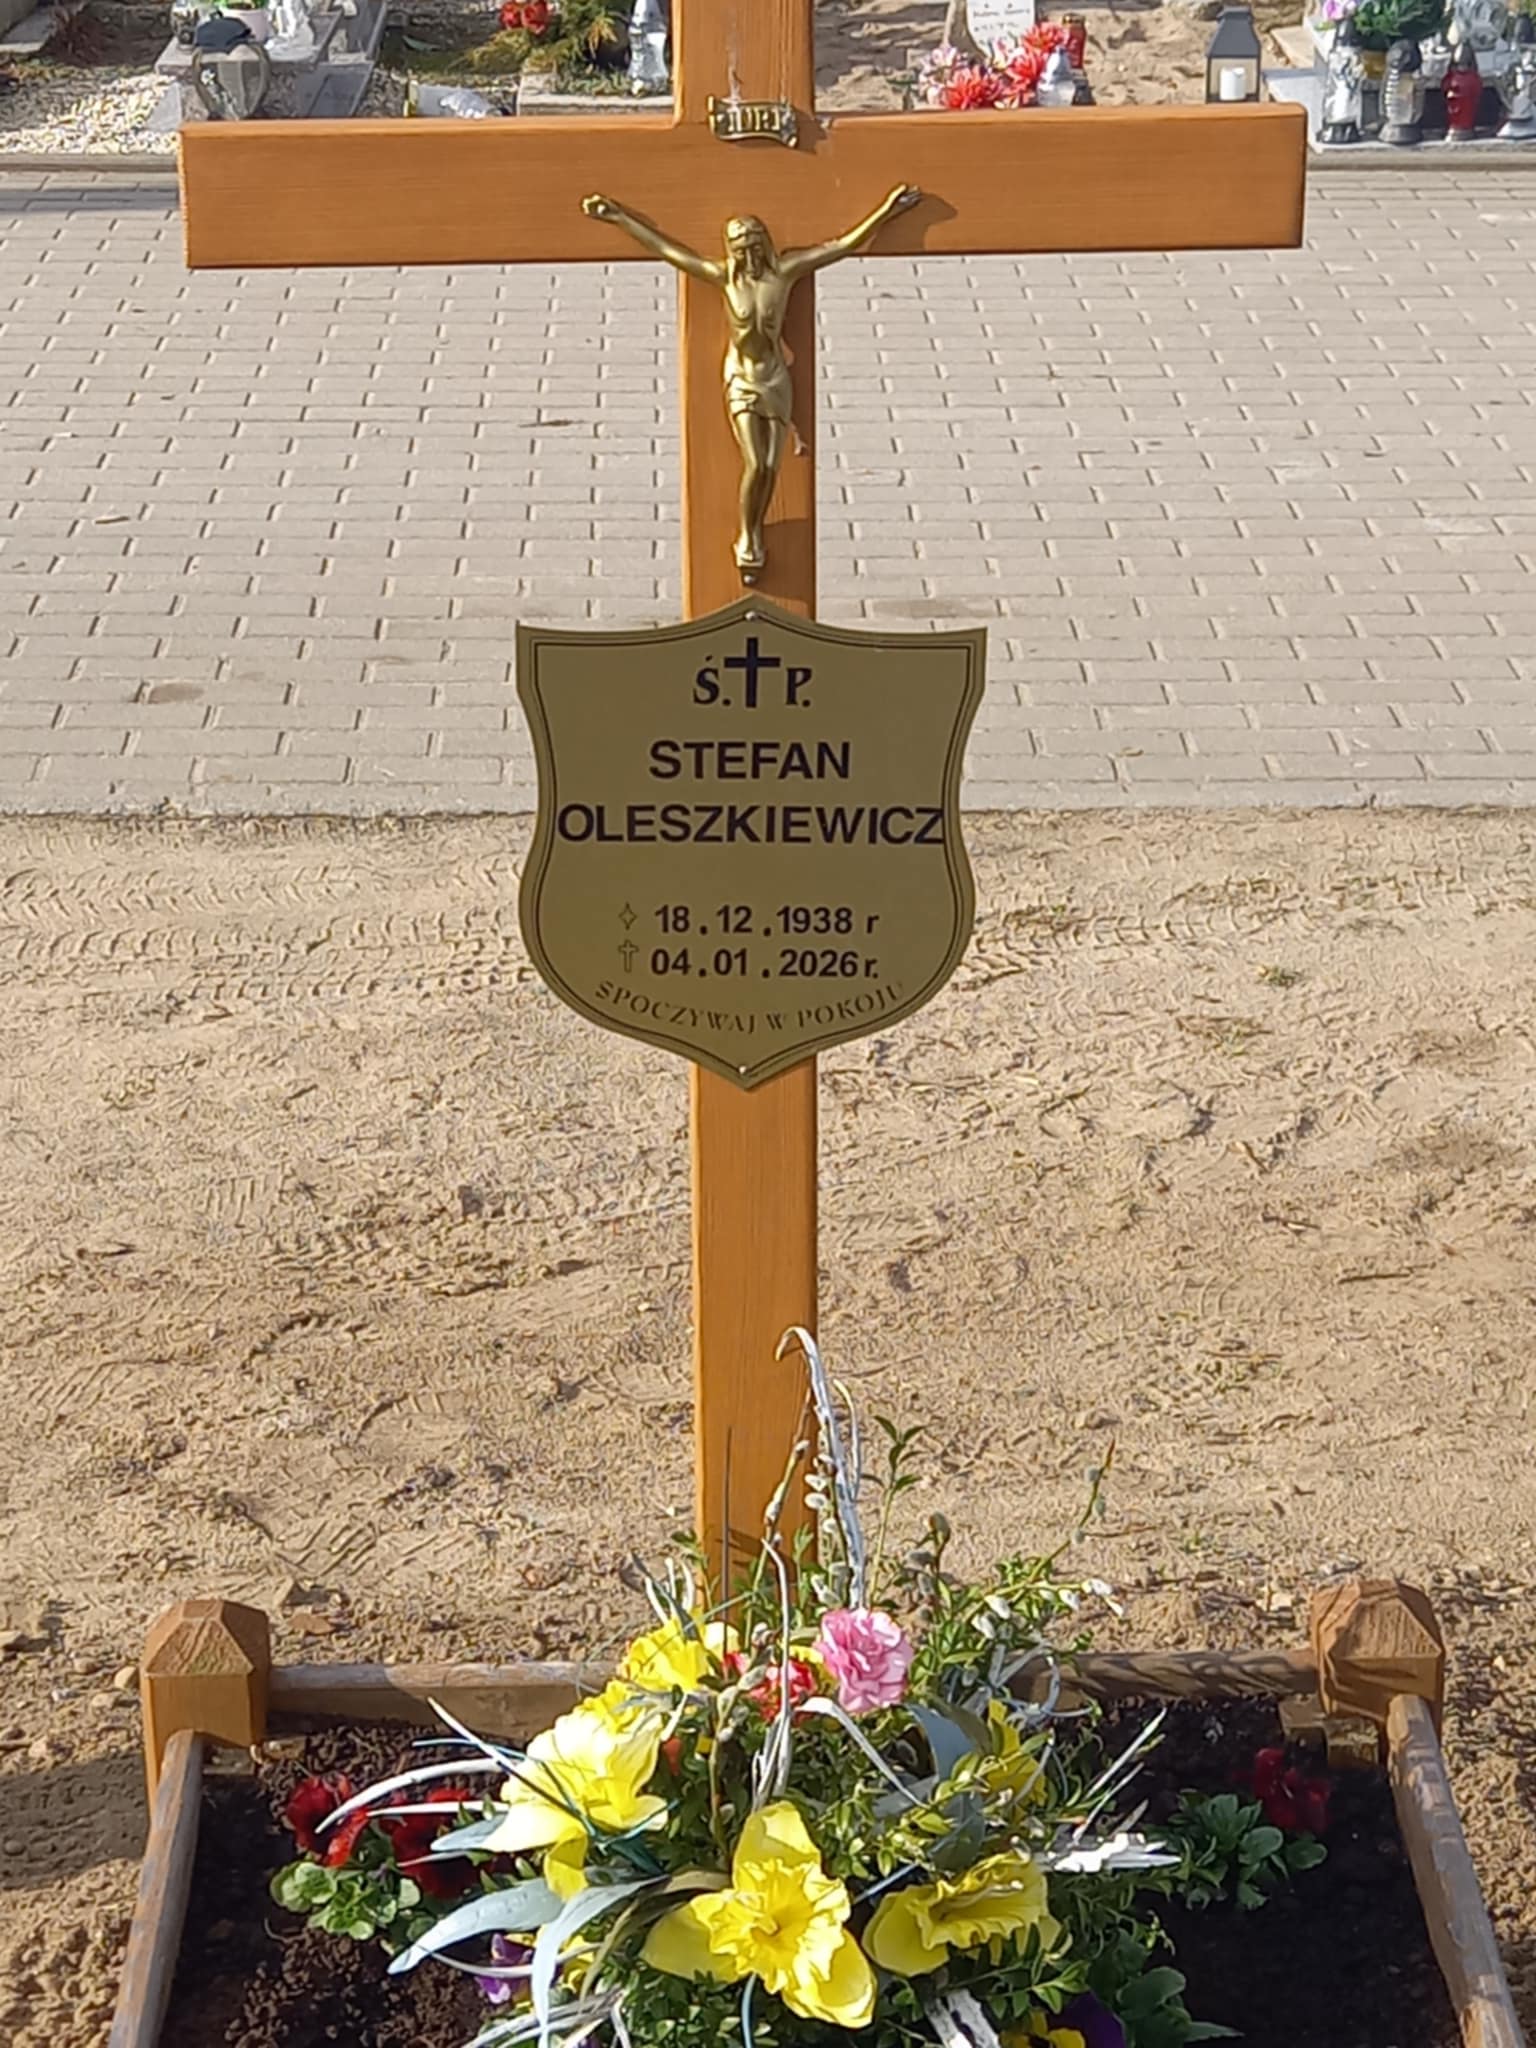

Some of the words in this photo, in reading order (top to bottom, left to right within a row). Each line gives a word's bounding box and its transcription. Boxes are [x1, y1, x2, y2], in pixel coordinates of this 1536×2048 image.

[785, 667, 812, 707] P.
[649, 740, 850, 779] STEFAN
[557, 803, 944, 844] OLESZKIEWICZ
[594, 979, 756, 1034] SPOCZYWAJ
[766, 1013, 787, 1031] W
[799, 983, 903, 1029] POKOJU
